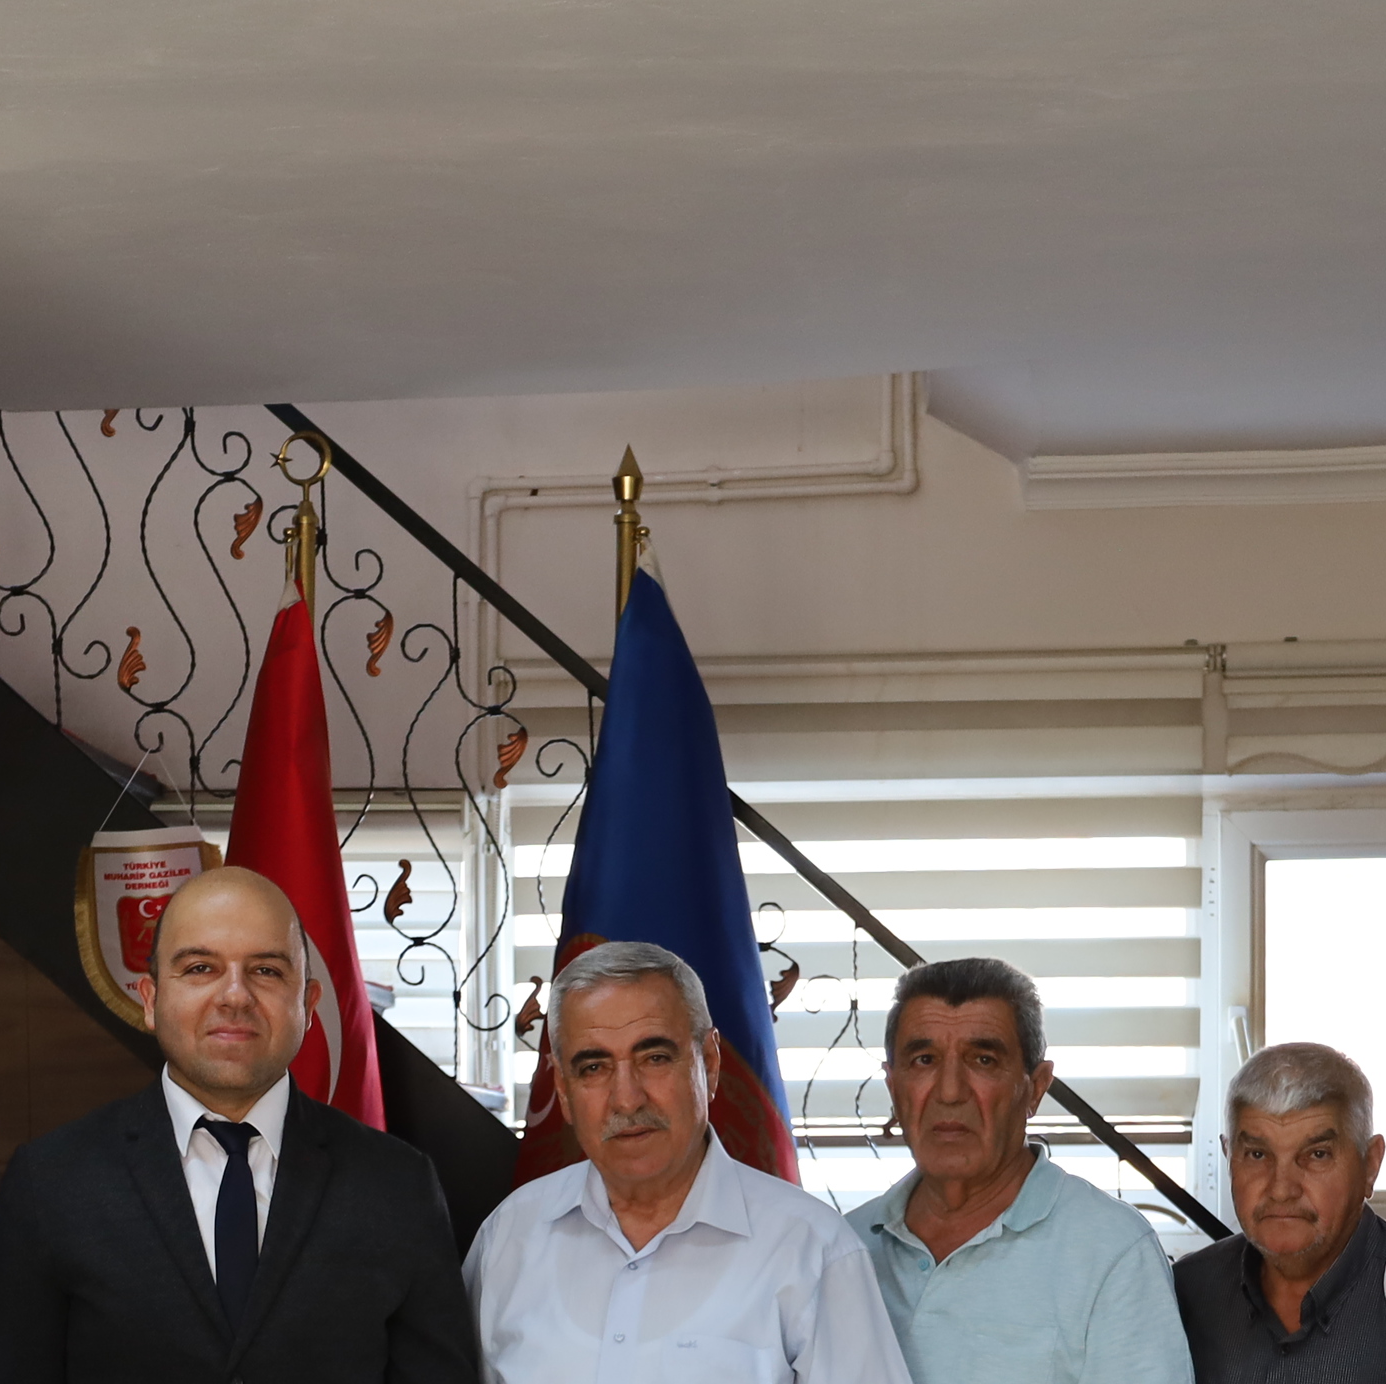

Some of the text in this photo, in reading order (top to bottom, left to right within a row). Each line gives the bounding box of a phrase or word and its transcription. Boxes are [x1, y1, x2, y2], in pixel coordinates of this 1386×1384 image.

[123, 860, 167, 870] TÜRKİYE
[103, 868, 191, 881] MUHARİP GAZİLER
[124, 879, 169, 890] DERNEĞİ
